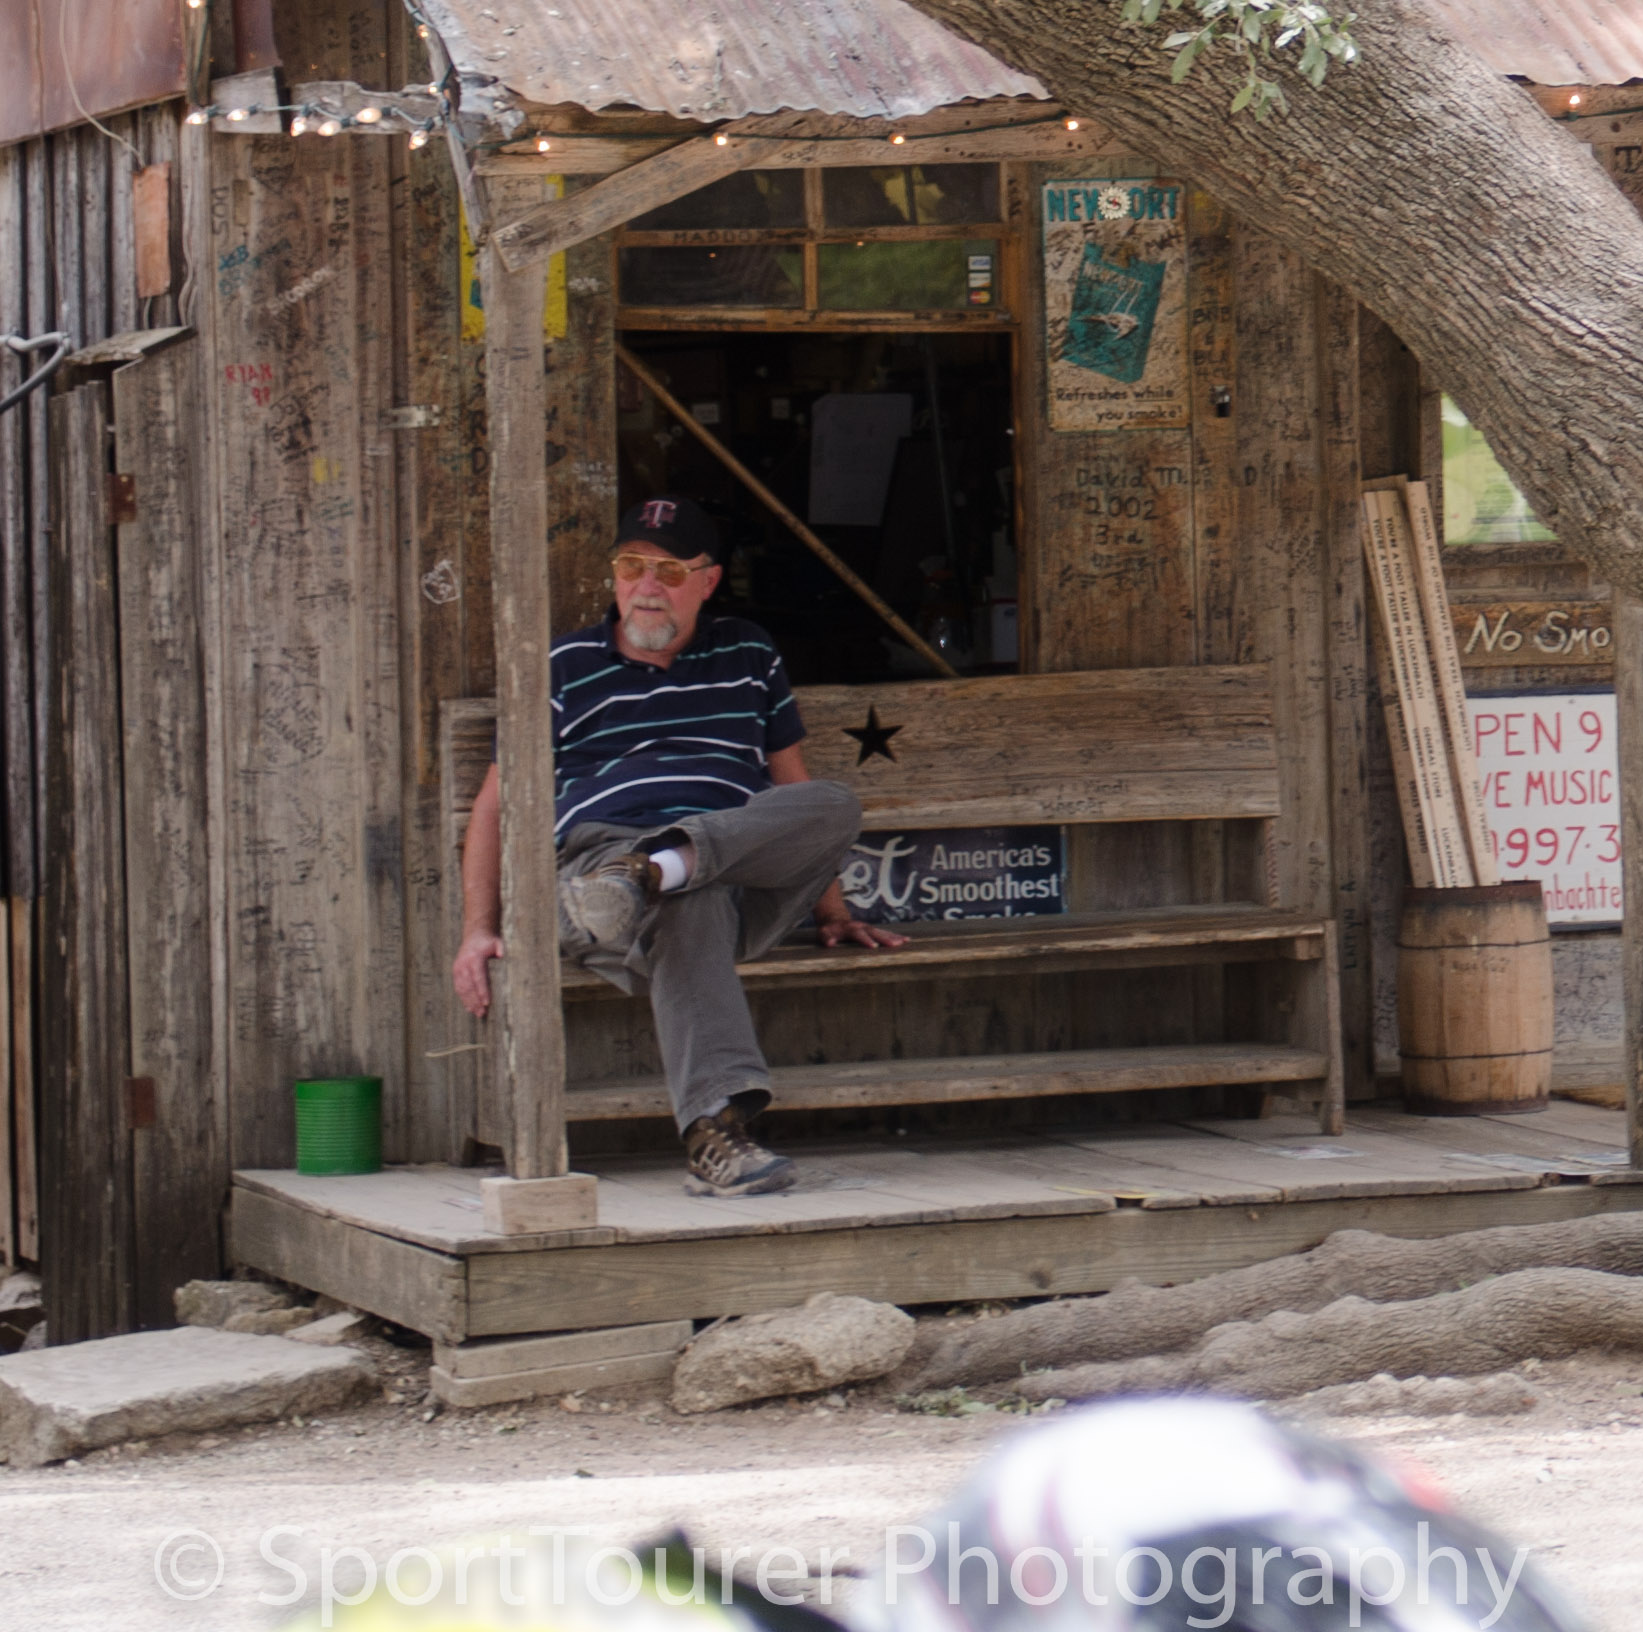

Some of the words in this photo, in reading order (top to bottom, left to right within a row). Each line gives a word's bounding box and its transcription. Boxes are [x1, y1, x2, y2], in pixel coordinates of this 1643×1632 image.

[1047, 185, 1180, 223] NEWORT
[1132, 384, 1175, 401] while
[1096, 410, 1123, 424] you
[1076, 465, 1146, 489] David
[1085, 495, 1161, 521] 2002
[1464, 611, 1523, 655] No
[1474, 710, 1562, 757] PEN
[1579, 710, 1603, 753] 9
[1525, 769, 1613, 808] MUSIC
[930, 842, 1052, 871] America's
[918, 872, 1061, 905] Smoothest
